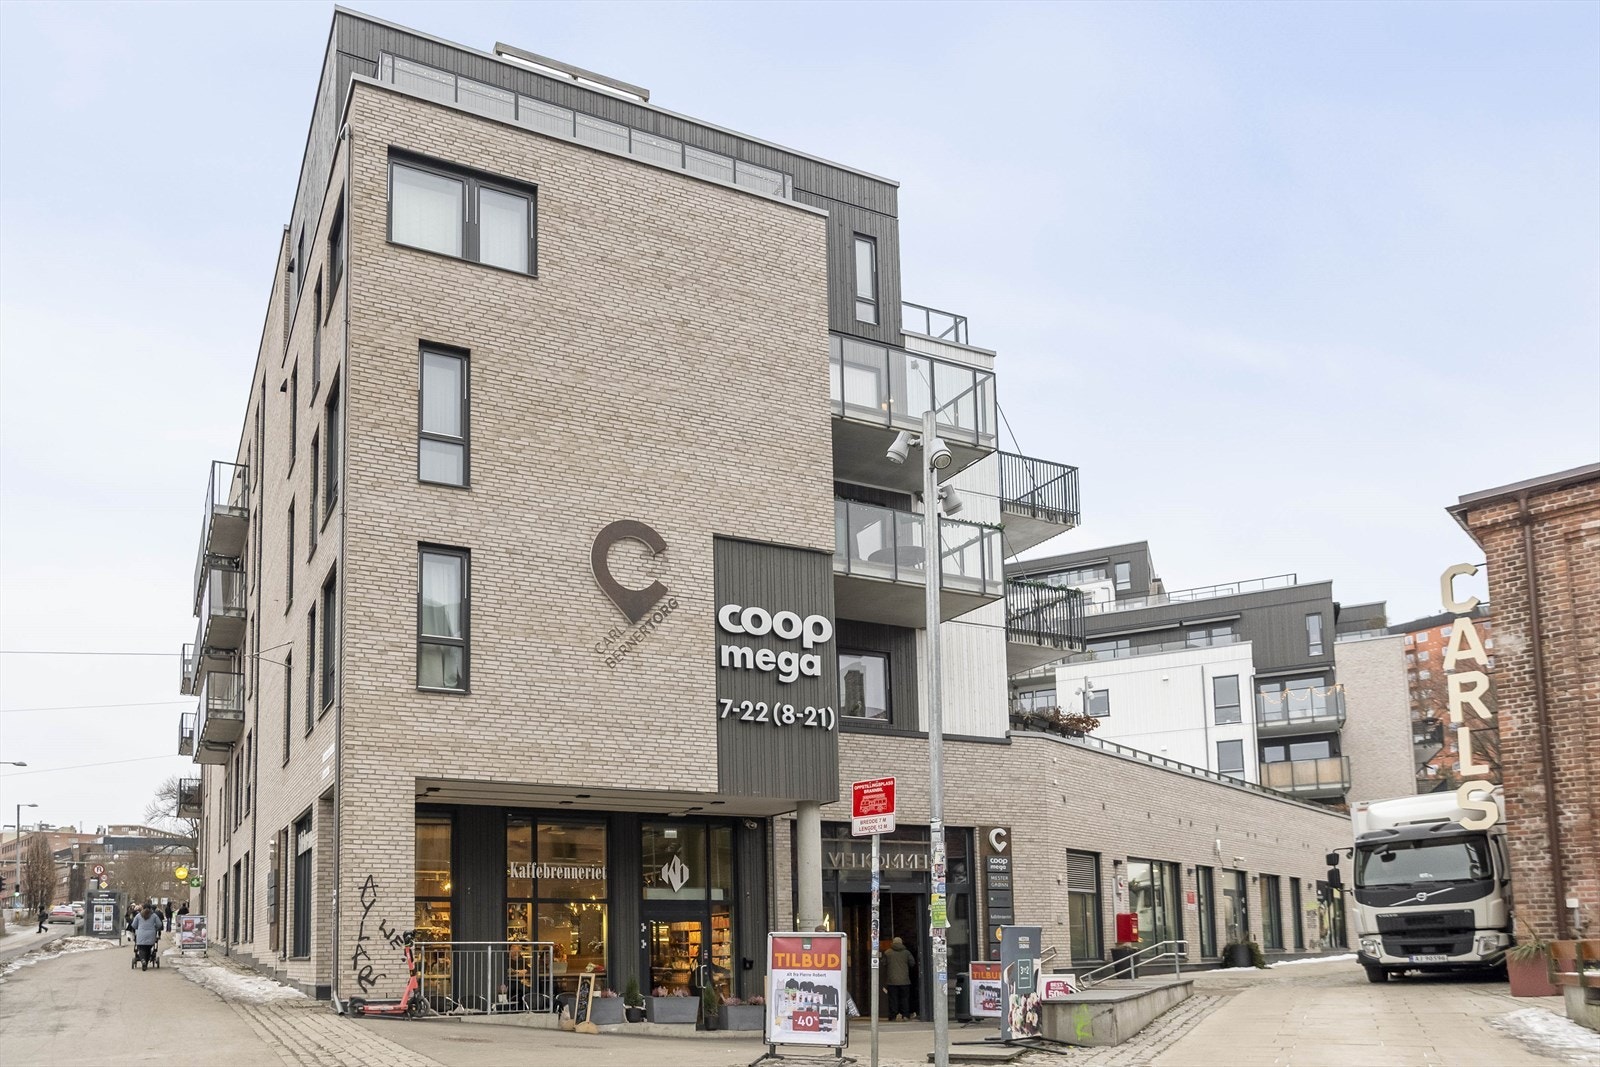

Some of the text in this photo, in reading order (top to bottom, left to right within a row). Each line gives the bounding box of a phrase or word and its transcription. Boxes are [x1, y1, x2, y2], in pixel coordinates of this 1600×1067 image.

[594, 625, 626, 654] CARL
[719, 604, 833, 648] coop
[721, 644, 821, 683] mega
[1440, 562, 1498, 830] CARLS
[720, 698, 835, 730] 7-22 (8-21)
[510, 861, 607, 880] Kaffebrenneriet
[774, 953, 840, 968] TILBUD
[973, 971, 1001, 979] TILBU
